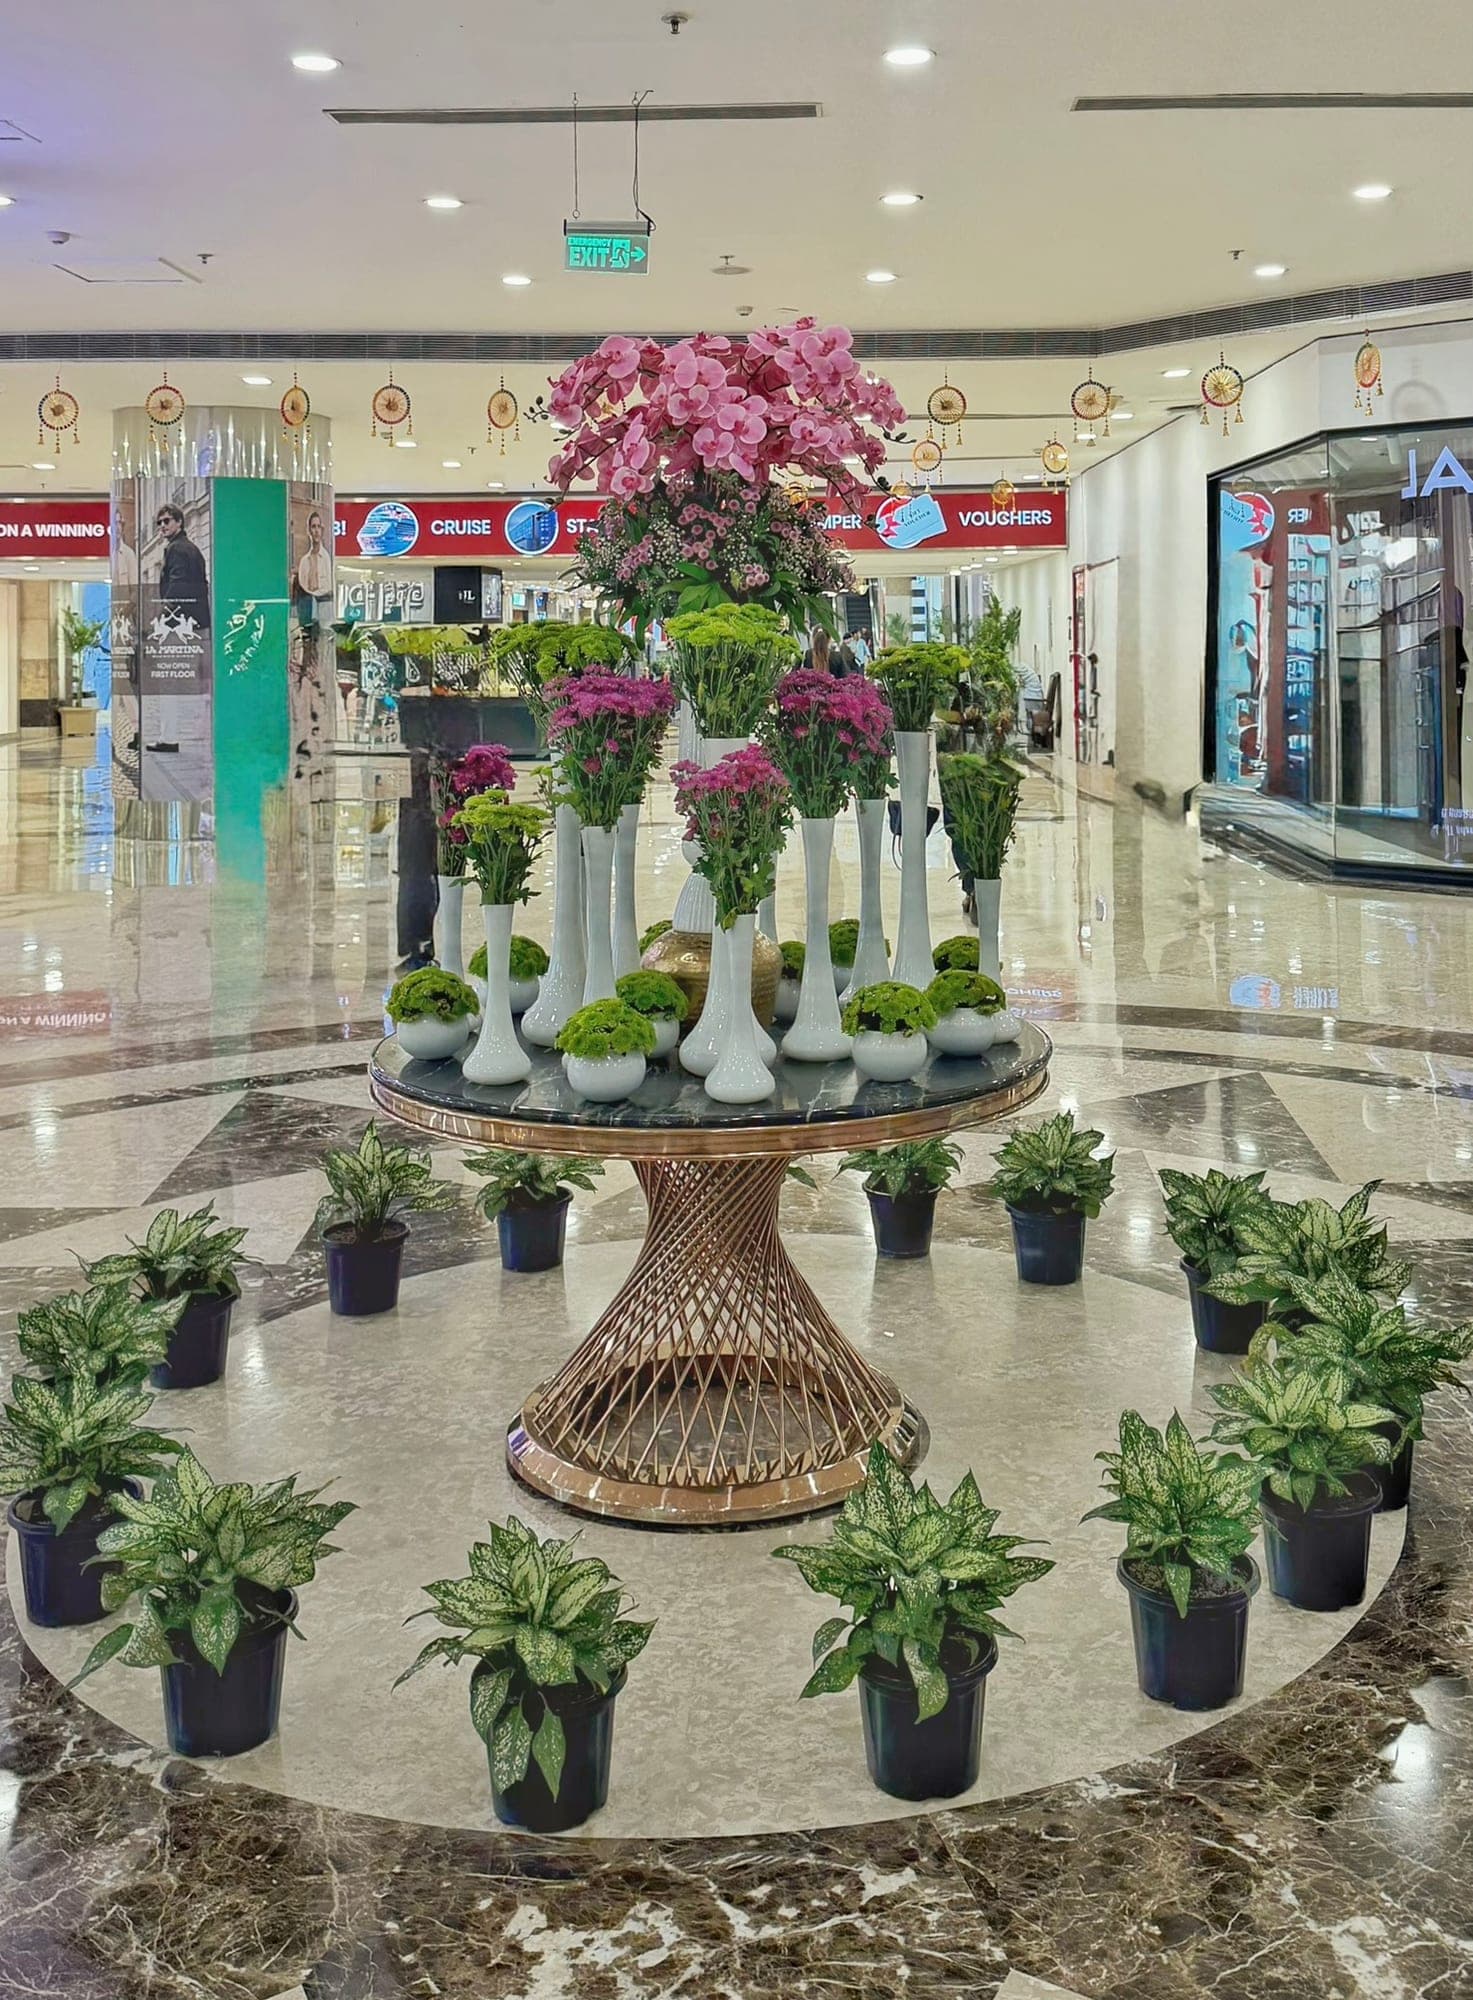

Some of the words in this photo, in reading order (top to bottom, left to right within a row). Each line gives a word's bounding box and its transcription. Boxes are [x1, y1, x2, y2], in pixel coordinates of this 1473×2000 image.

[569, 246, 610, 268] EXIT
[958, 509, 1052, 526] VOUCHERS
[20, 523, 33, 537] A
[35, 523, 105, 537] WINNING
[430, 519, 491, 535] CRUISE
